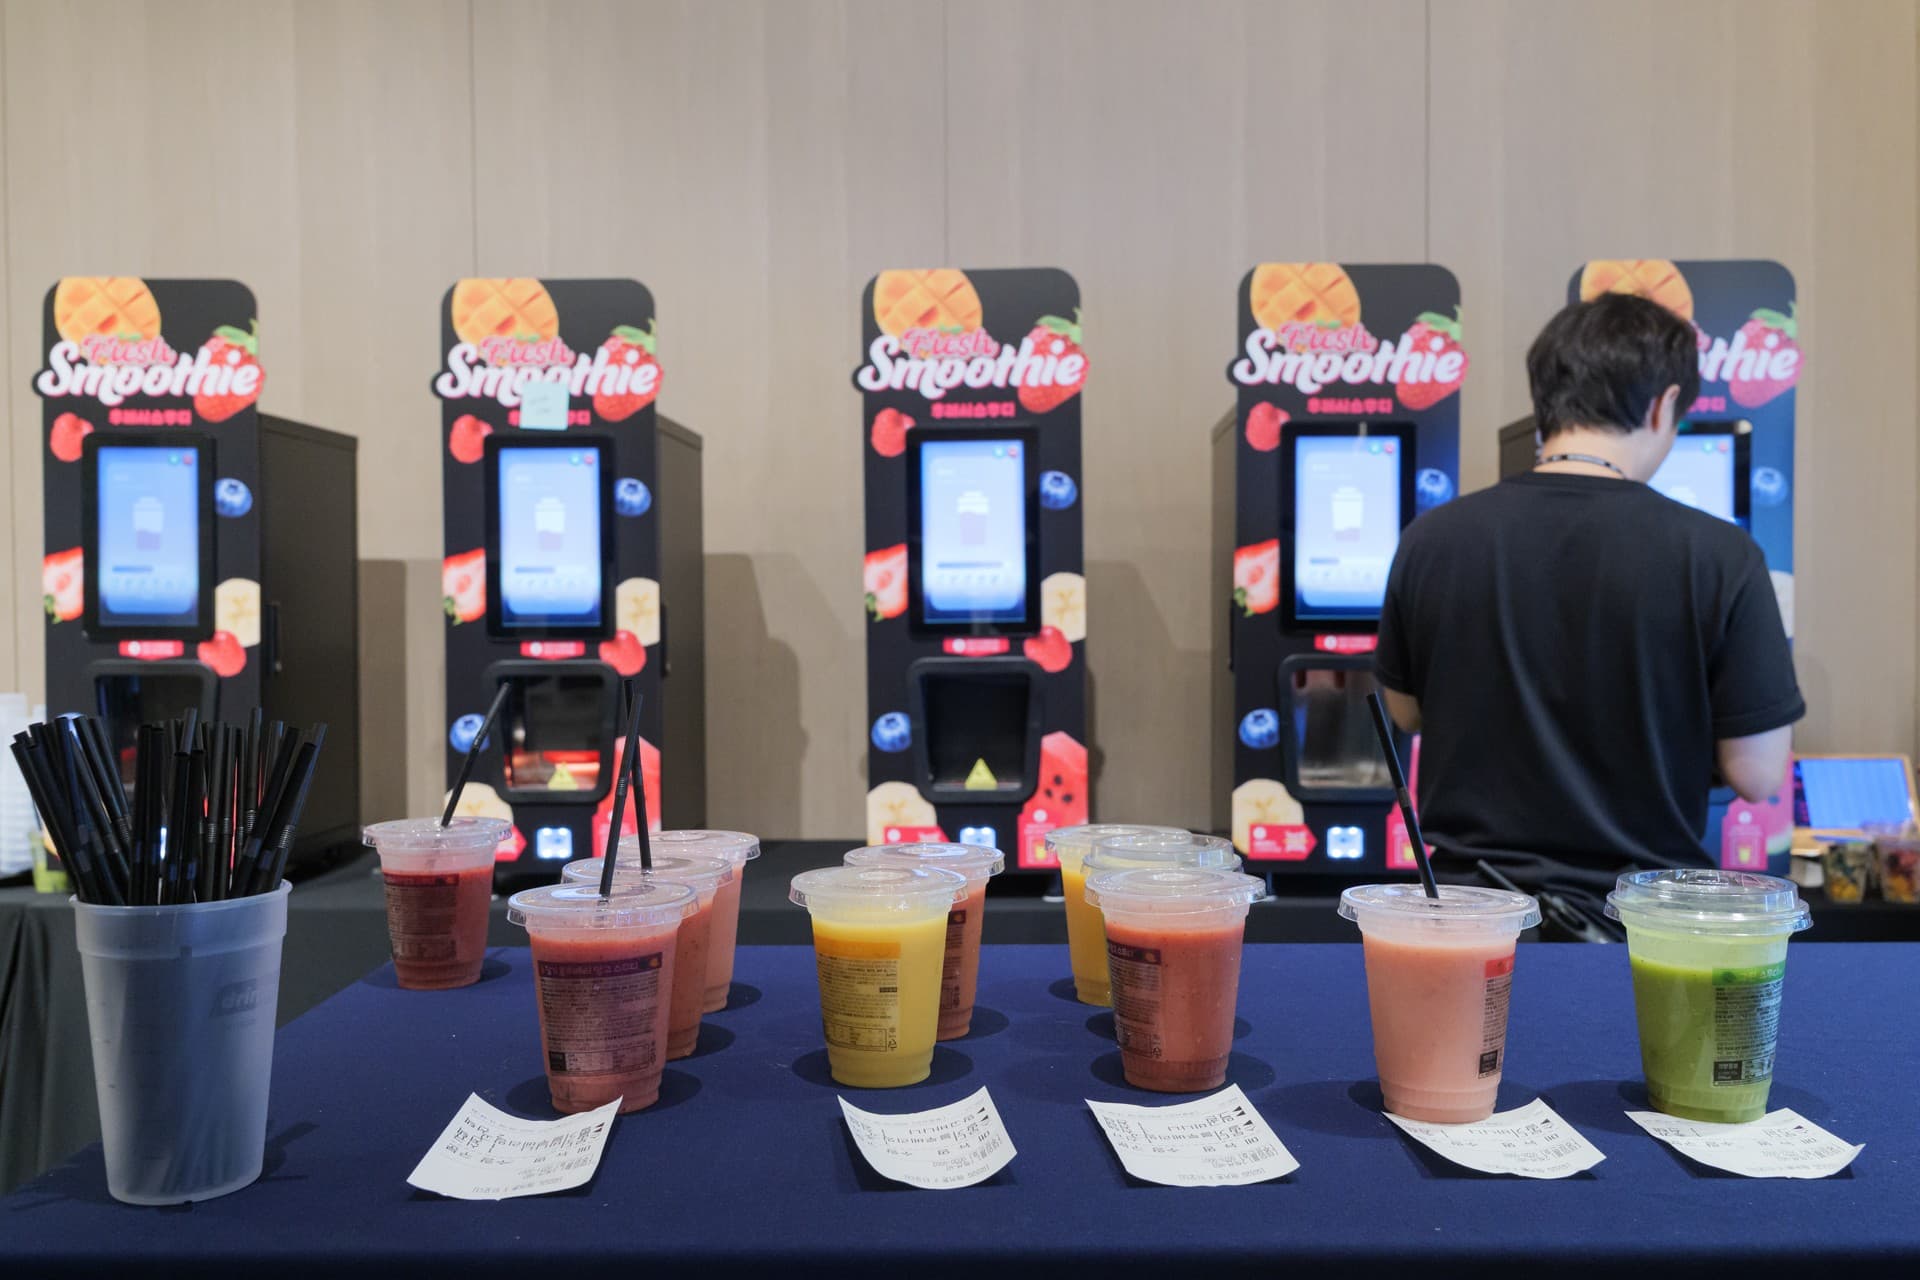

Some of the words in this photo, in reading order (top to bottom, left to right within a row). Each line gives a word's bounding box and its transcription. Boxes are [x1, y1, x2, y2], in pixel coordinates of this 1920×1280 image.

[36, 340, 261, 406] Smoothie
[857, 335, 1085, 400] Smoothie
[1232, 328, 1465, 395] Smoothie
